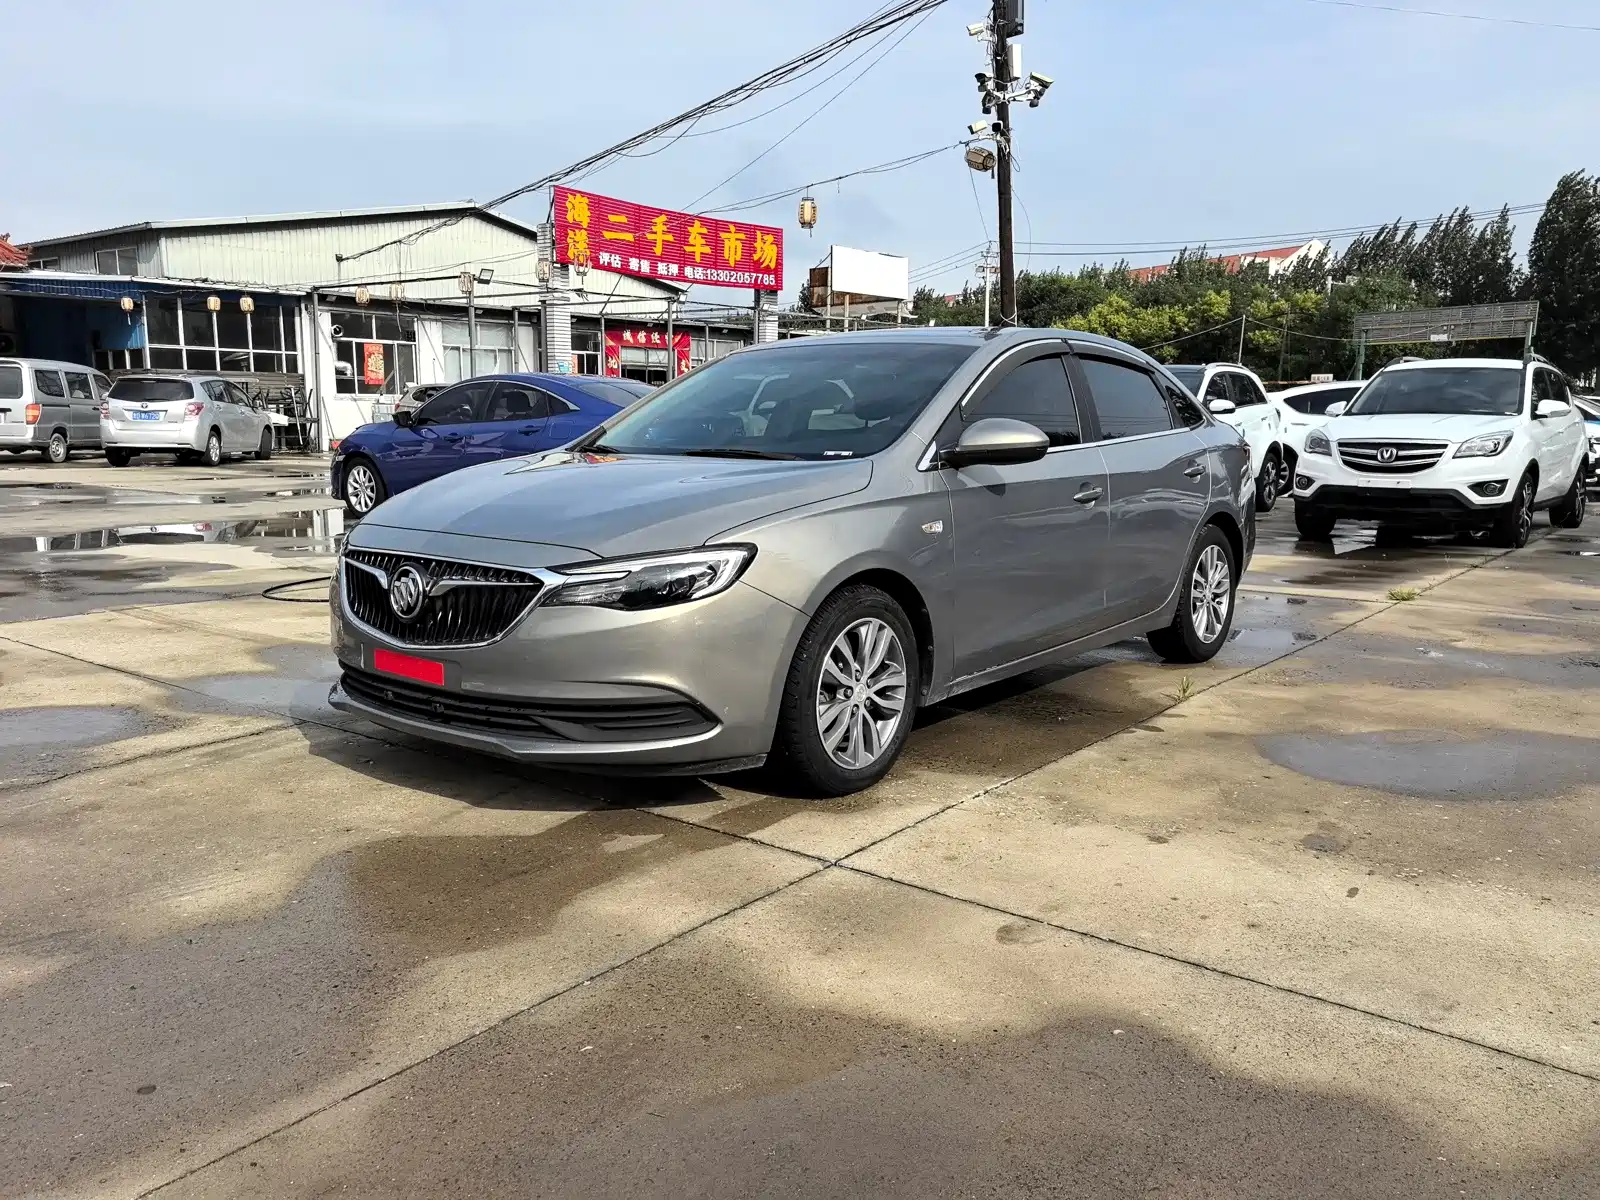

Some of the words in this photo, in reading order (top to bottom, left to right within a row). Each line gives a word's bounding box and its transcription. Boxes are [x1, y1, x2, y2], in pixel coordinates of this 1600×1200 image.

[602, 214, 778, 269] 二手车市场
[599, 252, 622, 268] 评估
[629, 257, 651, 273] 寄售
[657, 262, 679, 276] 抵押
